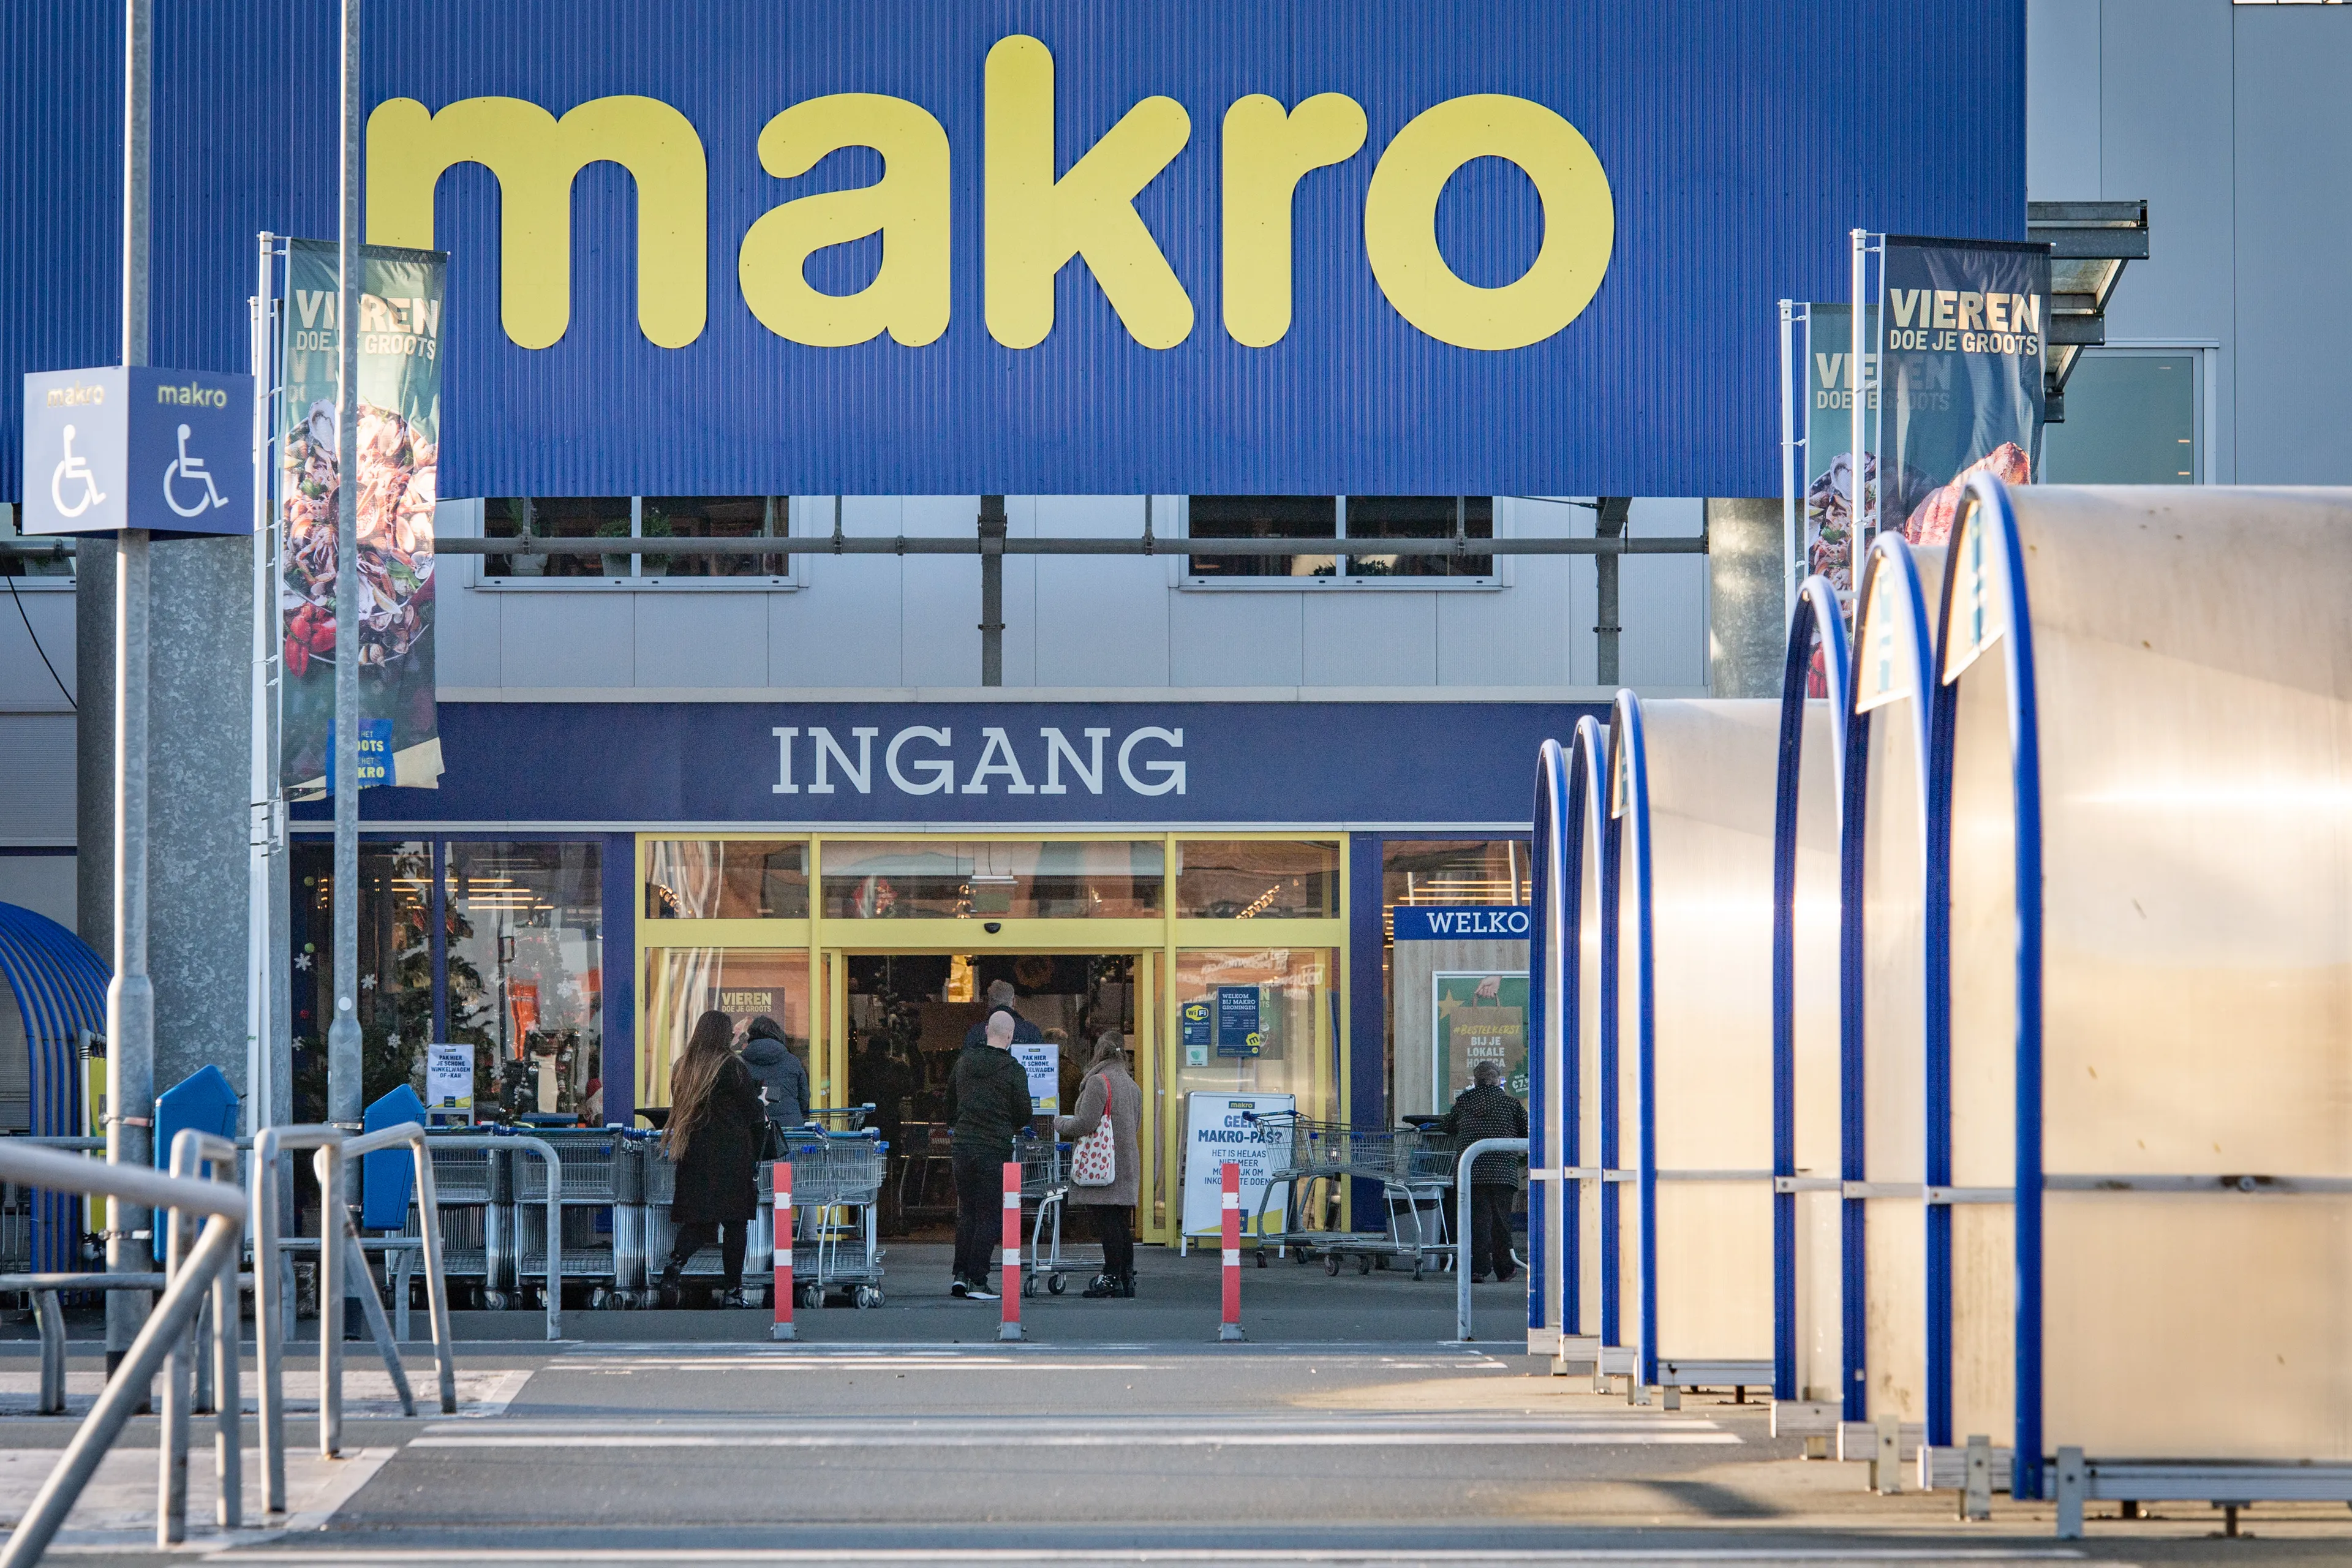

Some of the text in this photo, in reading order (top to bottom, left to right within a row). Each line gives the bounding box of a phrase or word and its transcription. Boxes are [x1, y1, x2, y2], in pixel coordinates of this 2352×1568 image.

[366, 34, 1615, 350] makro
[296, 290, 439, 338] VIREN
[1890, 288, 2041, 334] VIEREN
[296, 331, 331, 351] DOE
[365, 334, 436, 360] GROOTS
[1891, 330, 2039, 356] DOE JE GROOTS
[47, 380, 104, 407] makro
[157, 381, 227, 408] makro
[1817, 391, 1853, 409] DOE
[358, 766, 385, 778] KRO
[772, 725, 1186, 796] INGANG
[1427, 911, 1529, 933] WELKO
[722, 992, 772, 1005] VIEREN
[1467, 1047, 1504, 1057] LOKALE
[1471, 1036, 1501, 1046] BIJ JE
[1466, 1058, 1506, 1068] HOCA
[1198, 1129, 1283, 1144] MAKRO-PAS?
